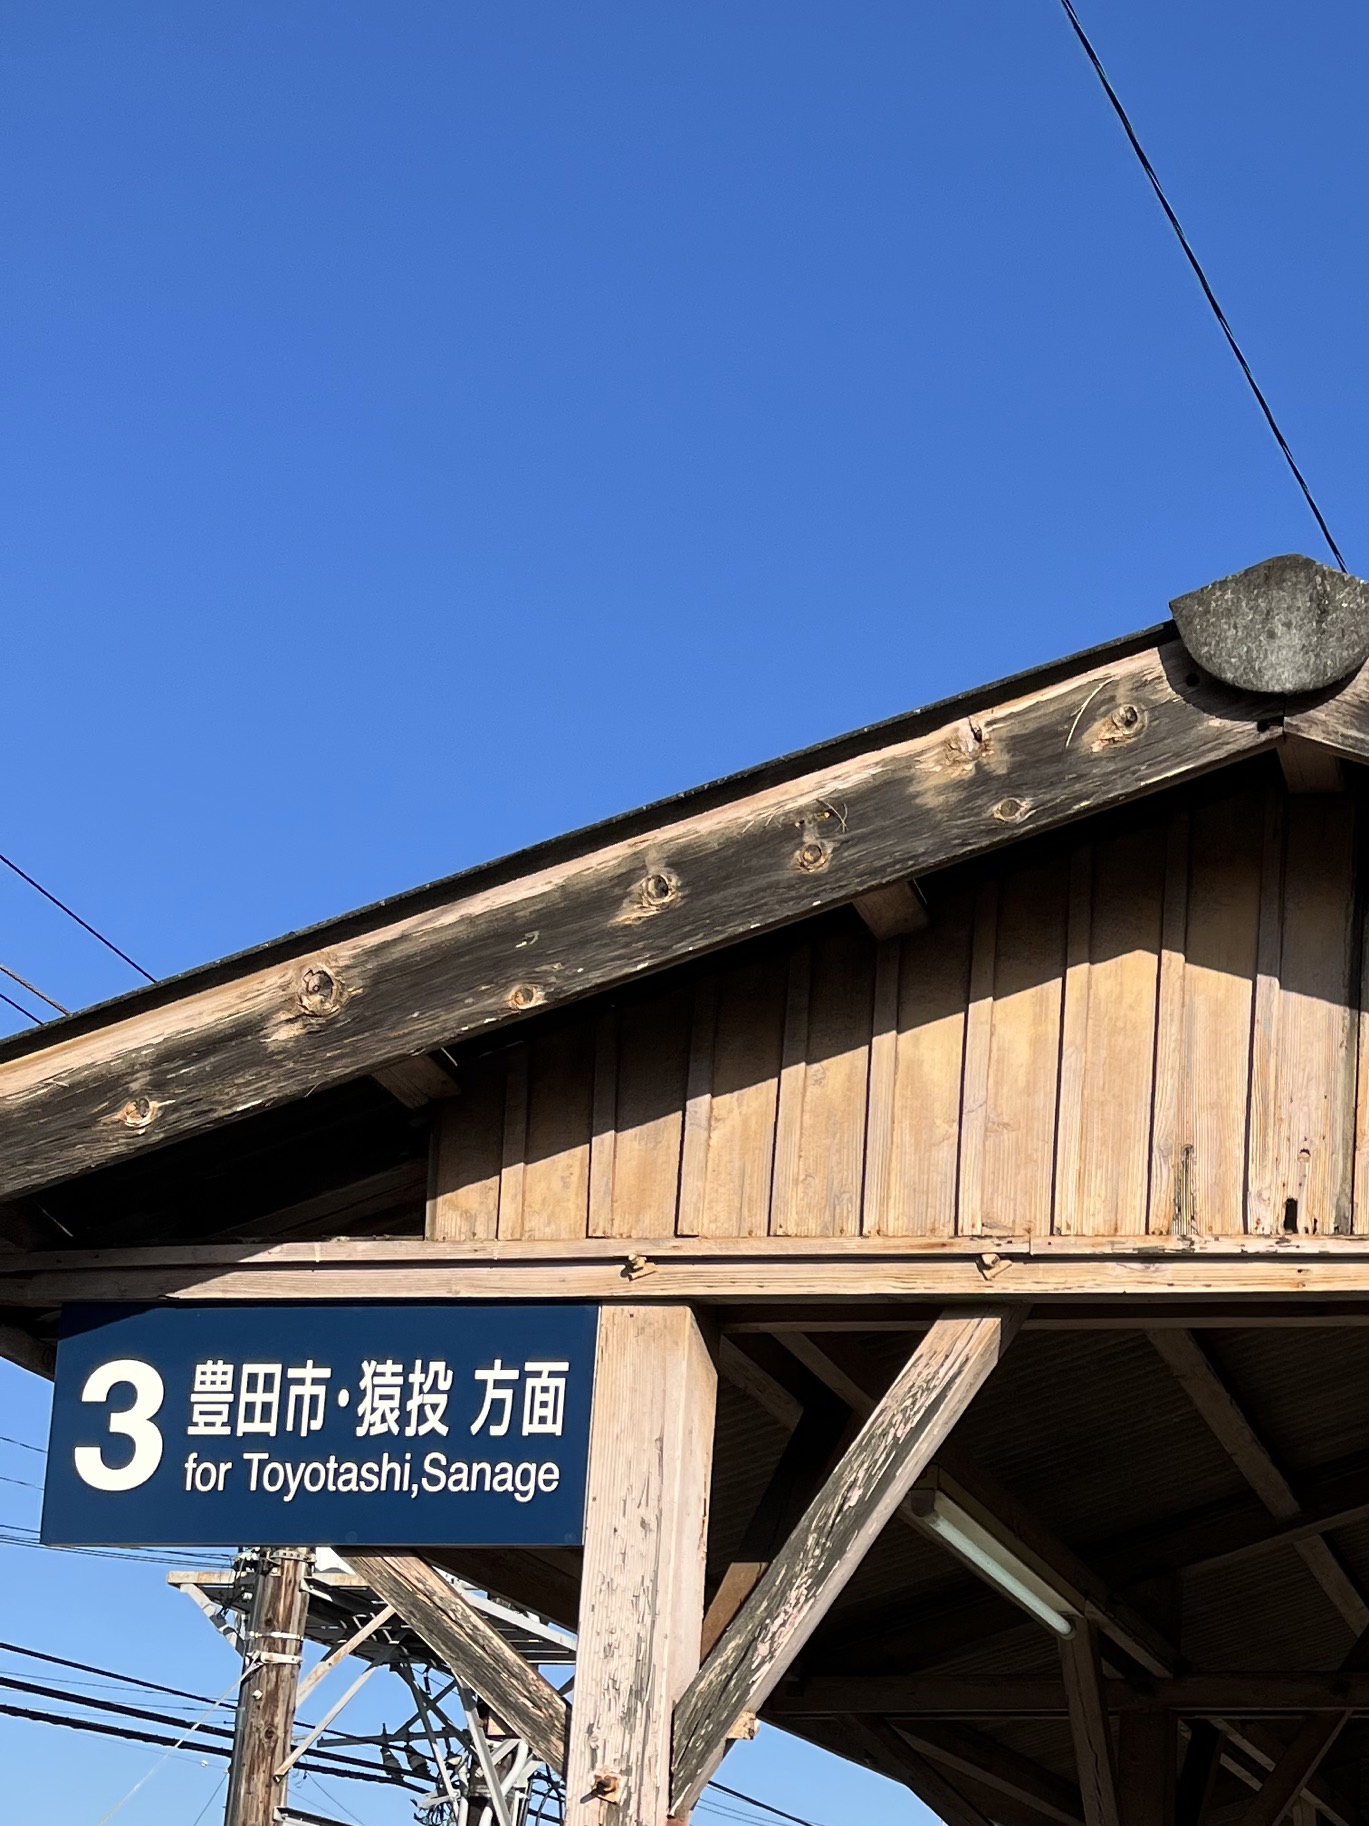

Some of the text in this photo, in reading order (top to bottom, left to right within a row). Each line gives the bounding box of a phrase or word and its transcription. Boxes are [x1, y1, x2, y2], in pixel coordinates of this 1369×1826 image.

[73, 1358, 165, 1492] 3
[470, 1360, 570, 1437] 方面
[184, 1452, 233, 1493] for
